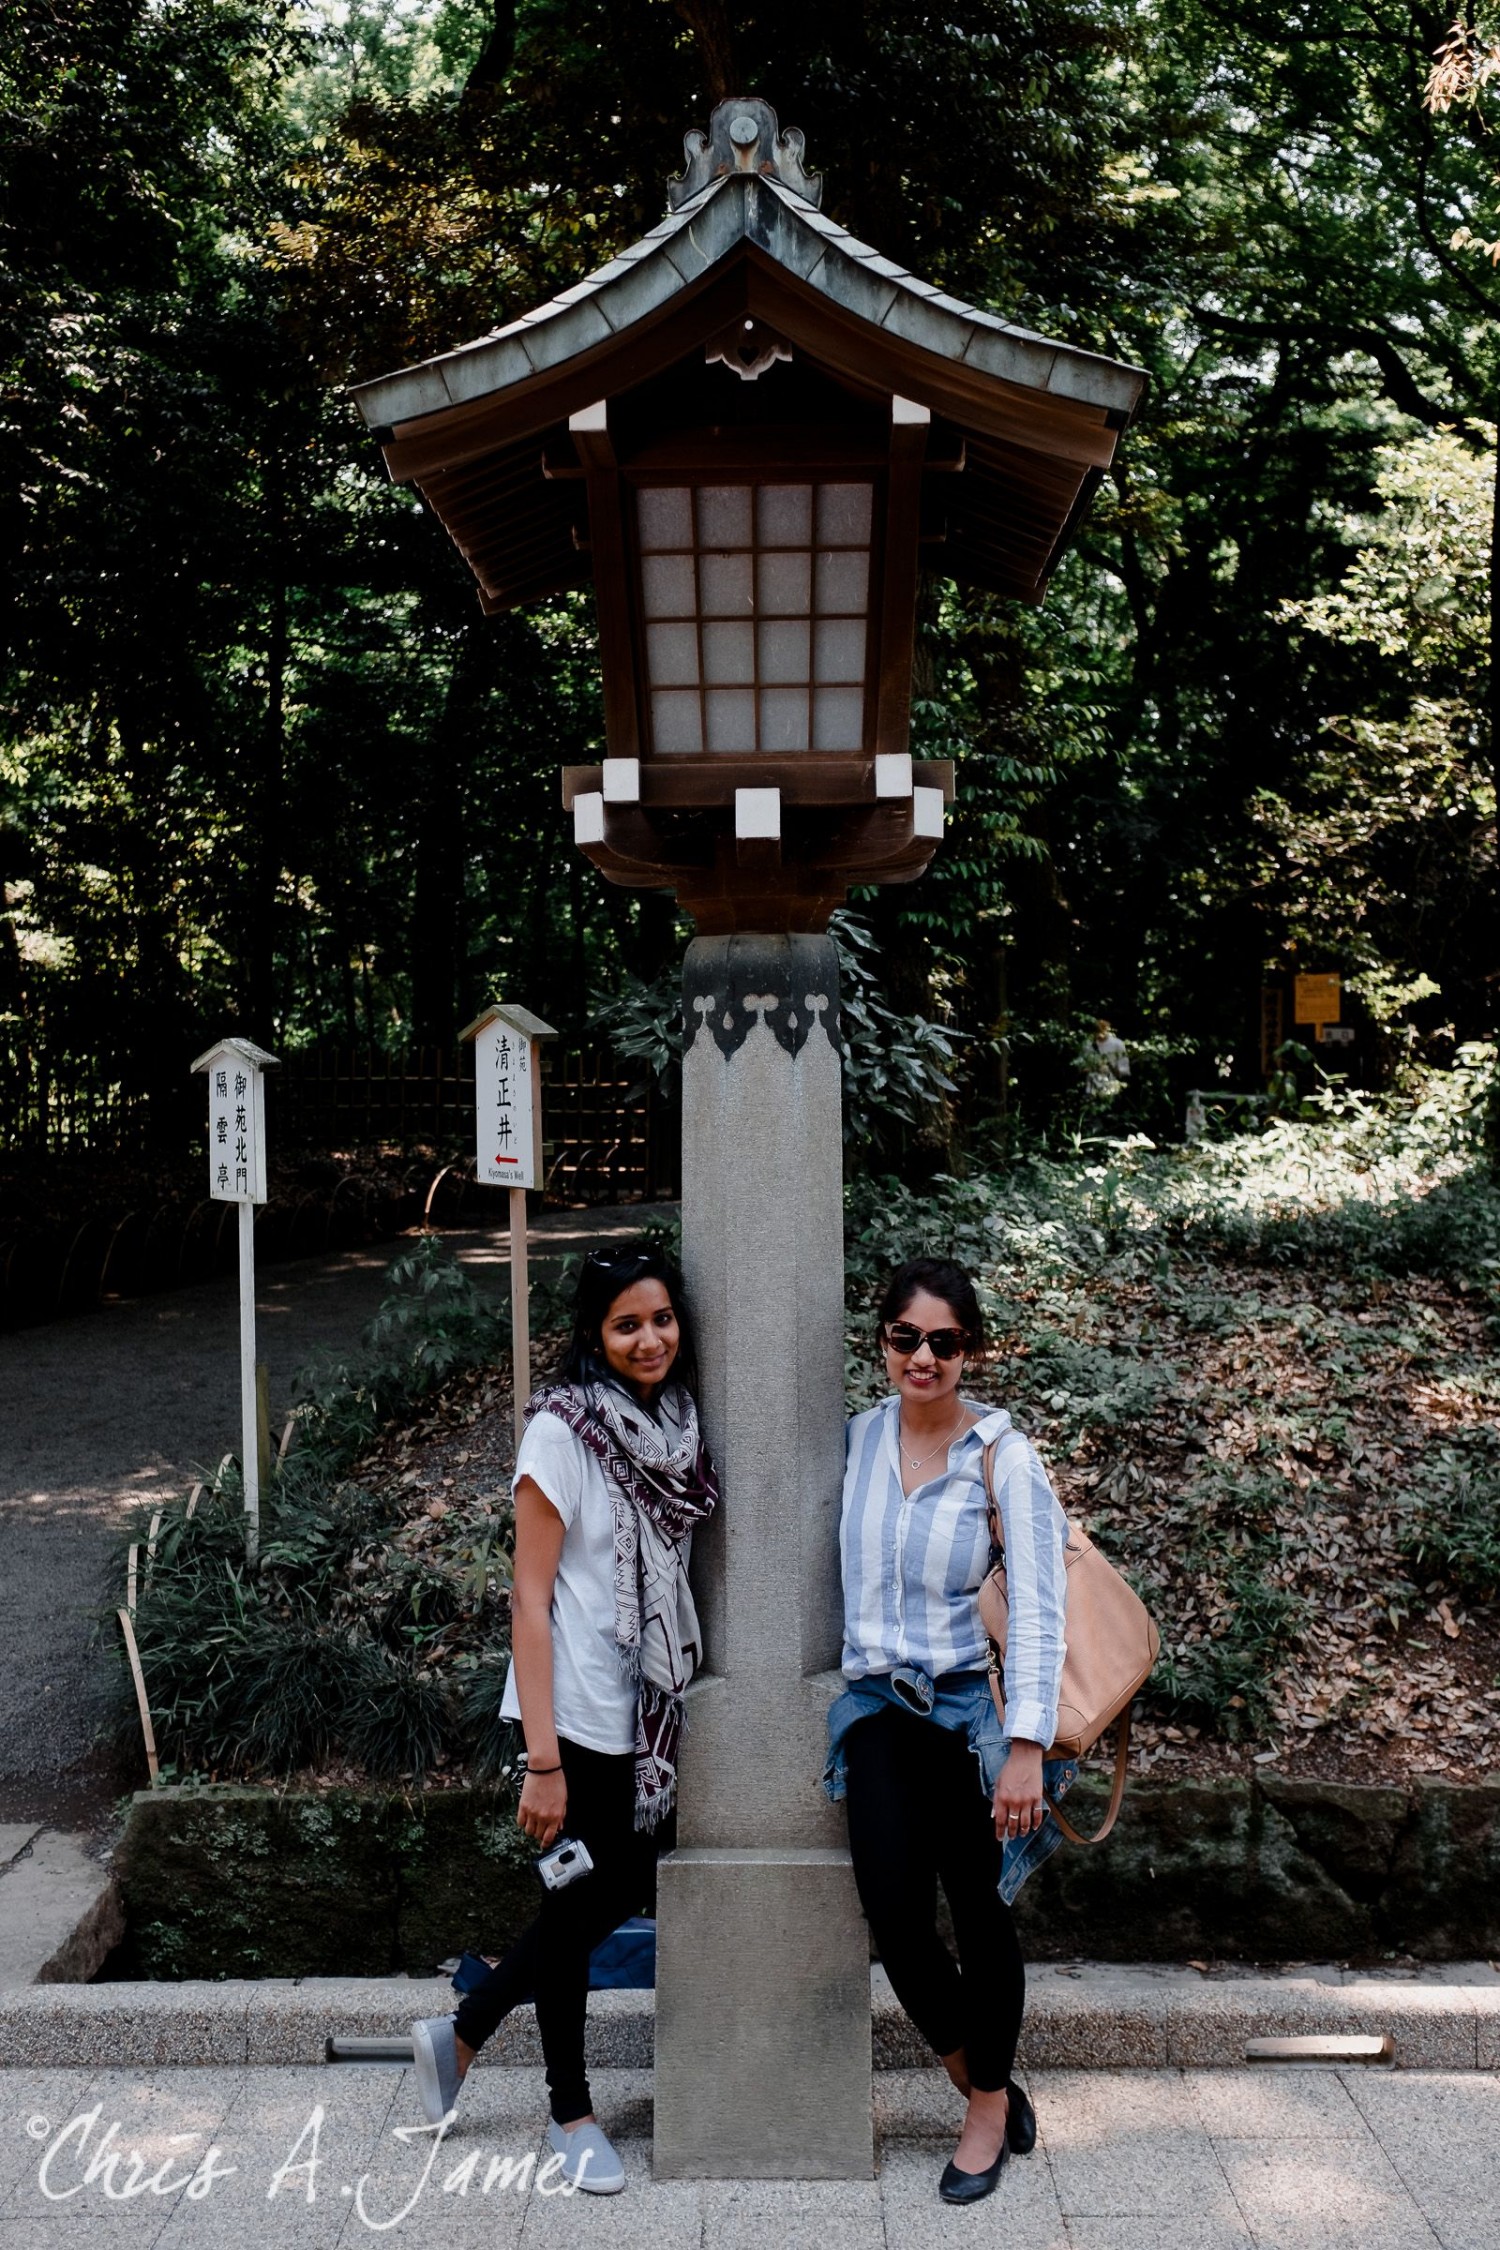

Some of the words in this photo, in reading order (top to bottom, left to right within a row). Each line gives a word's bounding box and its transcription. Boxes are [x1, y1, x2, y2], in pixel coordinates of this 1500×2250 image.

[216, 1071, 229, 1191] 隔雲亭
[234, 1071, 247, 1194] 御苑北門
[495, 1035, 512, 1150] 清正井
